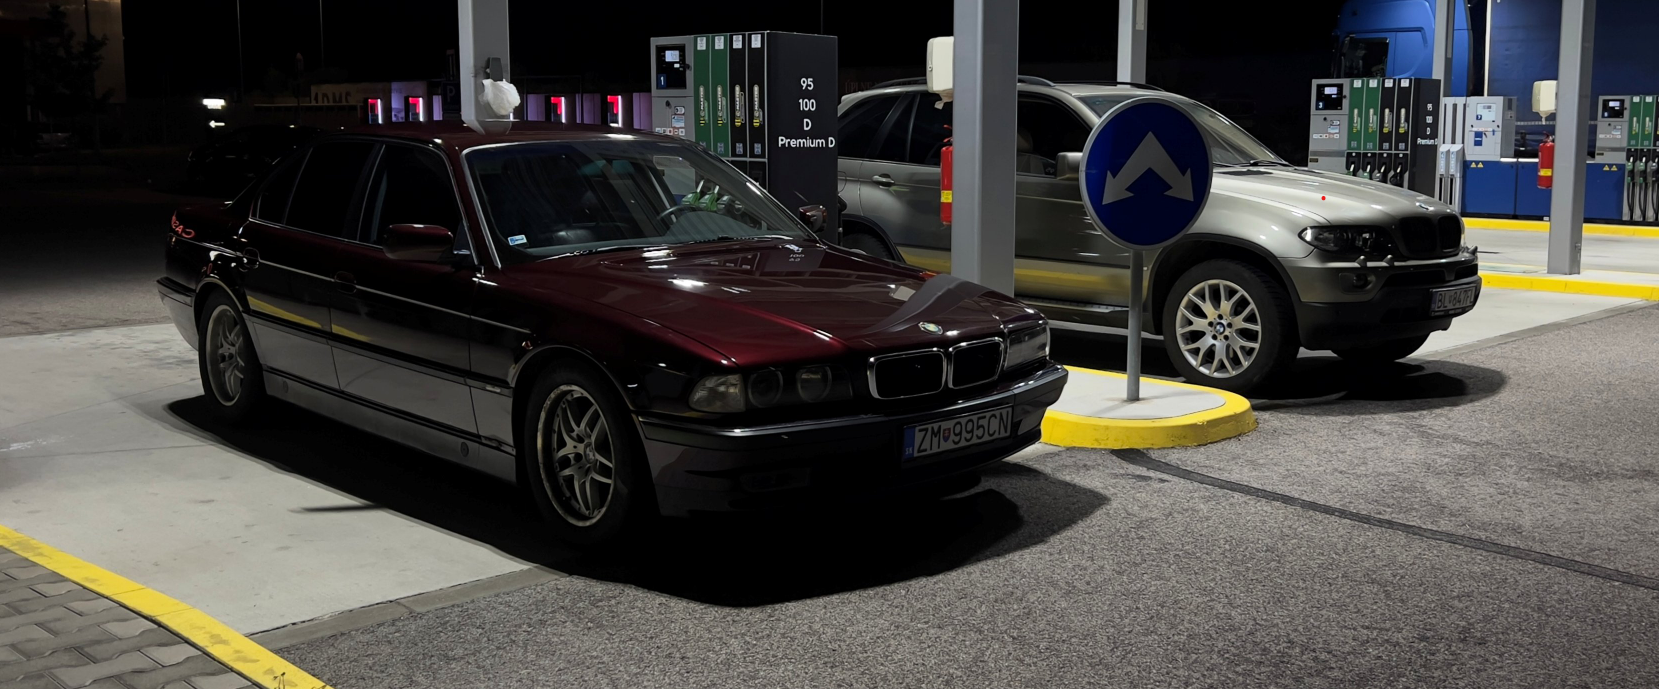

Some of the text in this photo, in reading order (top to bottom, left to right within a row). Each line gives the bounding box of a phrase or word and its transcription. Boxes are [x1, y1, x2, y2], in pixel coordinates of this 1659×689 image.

[660, 76, 664, 86] 1
[800, 77, 814, 91] 95
[798, 98, 816, 112] 100
[1426, 103, 1433, 111] 95
[803, 118, 812, 131] D
[1426, 127, 1431, 135] D
[778, 136, 836, 148] Premium D
[1437, 293, 1447, 309] BL
[916, 410, 1009, 454] ZM 995CN
